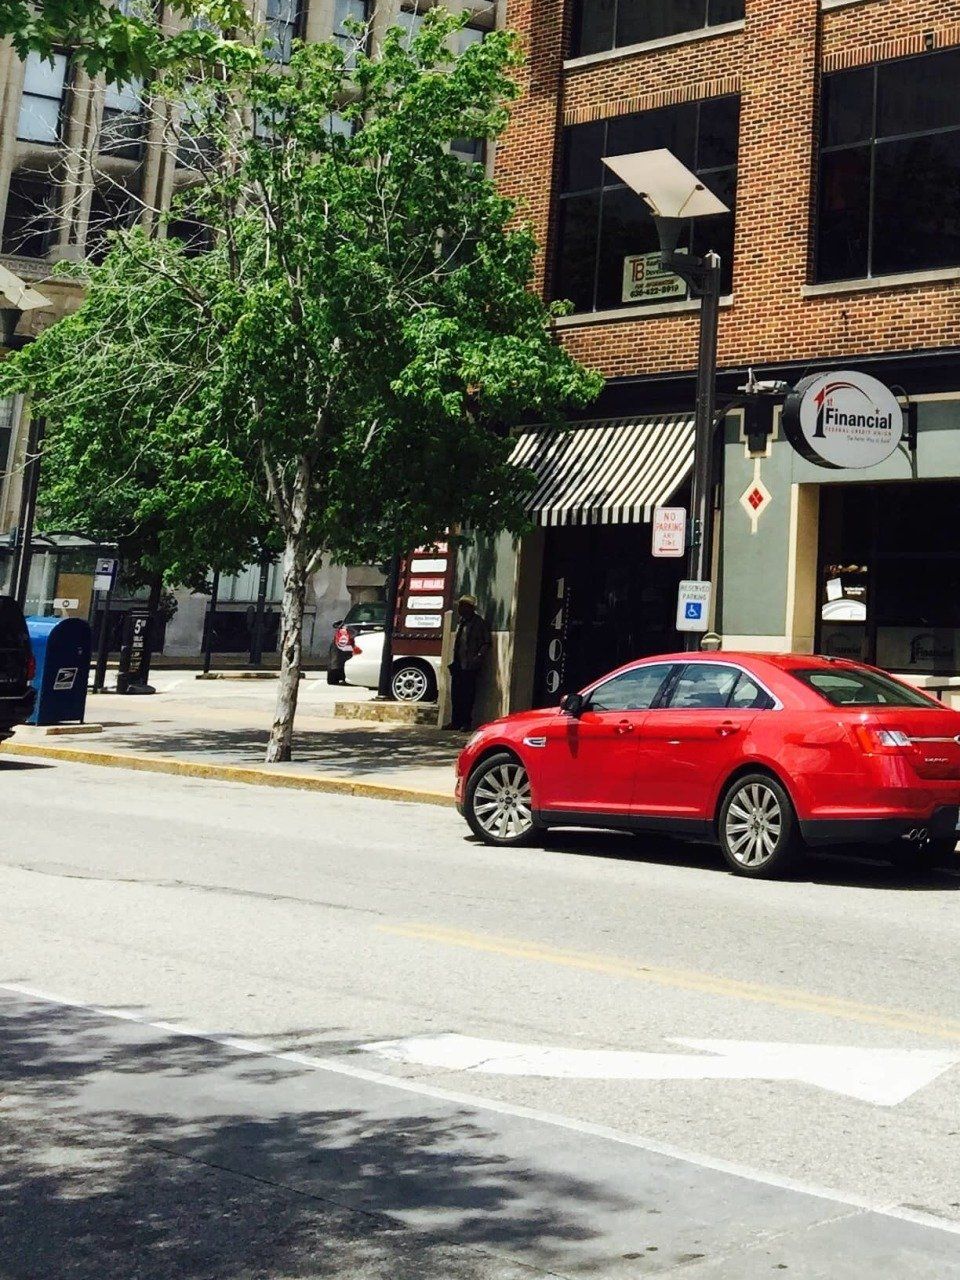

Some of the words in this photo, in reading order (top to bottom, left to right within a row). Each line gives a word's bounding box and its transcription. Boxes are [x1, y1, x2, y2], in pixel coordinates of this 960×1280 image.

[825, 407, 893, 430] Financial
[663, 512, 676, 521] NO
[655, 523, 683, 532] PARKING
[680, 585, 710, 593] RESERVED
[546, 578, 565, 693] 1409
